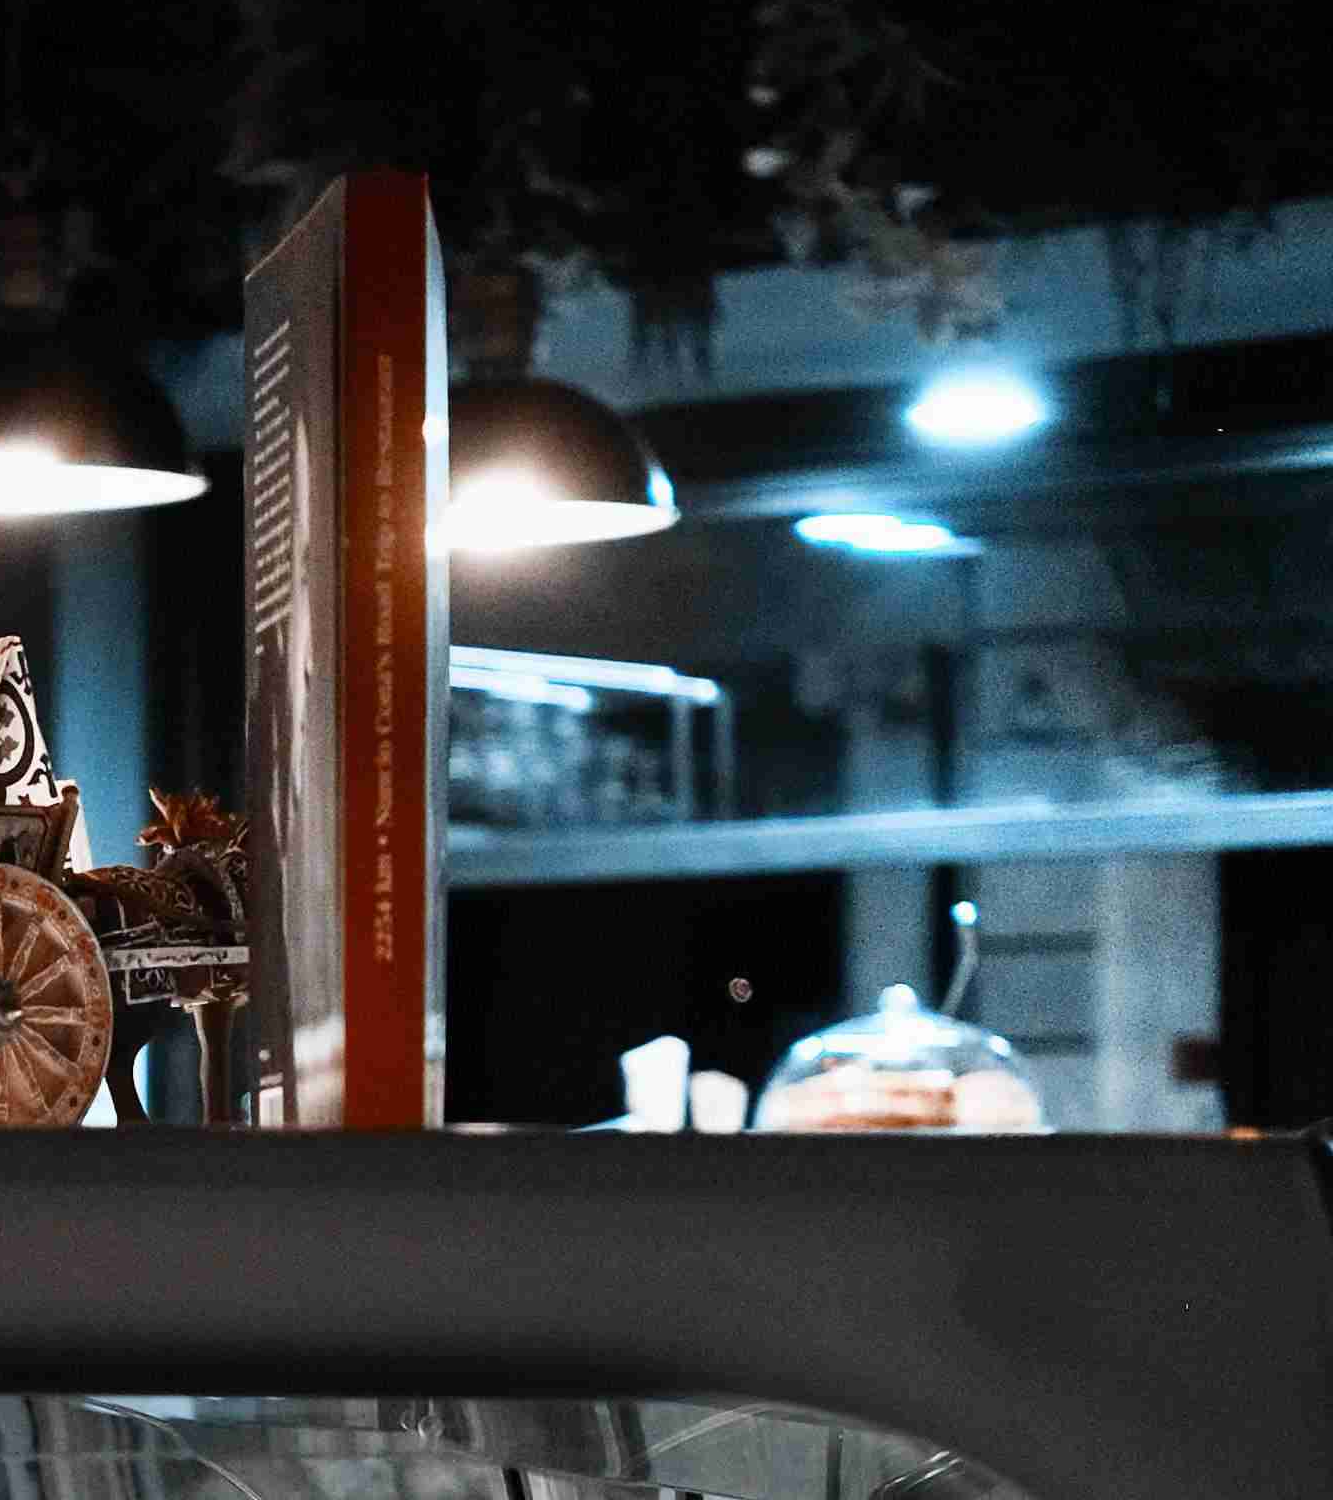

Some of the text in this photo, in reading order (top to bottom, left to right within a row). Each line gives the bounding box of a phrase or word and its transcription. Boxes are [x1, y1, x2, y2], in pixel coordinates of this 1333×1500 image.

[375, 523, 396, 572] Trip
[375, 580, 394, 646] Road
[374, 853, 393, 893] km
[374, 900, 393, 963] 2254
